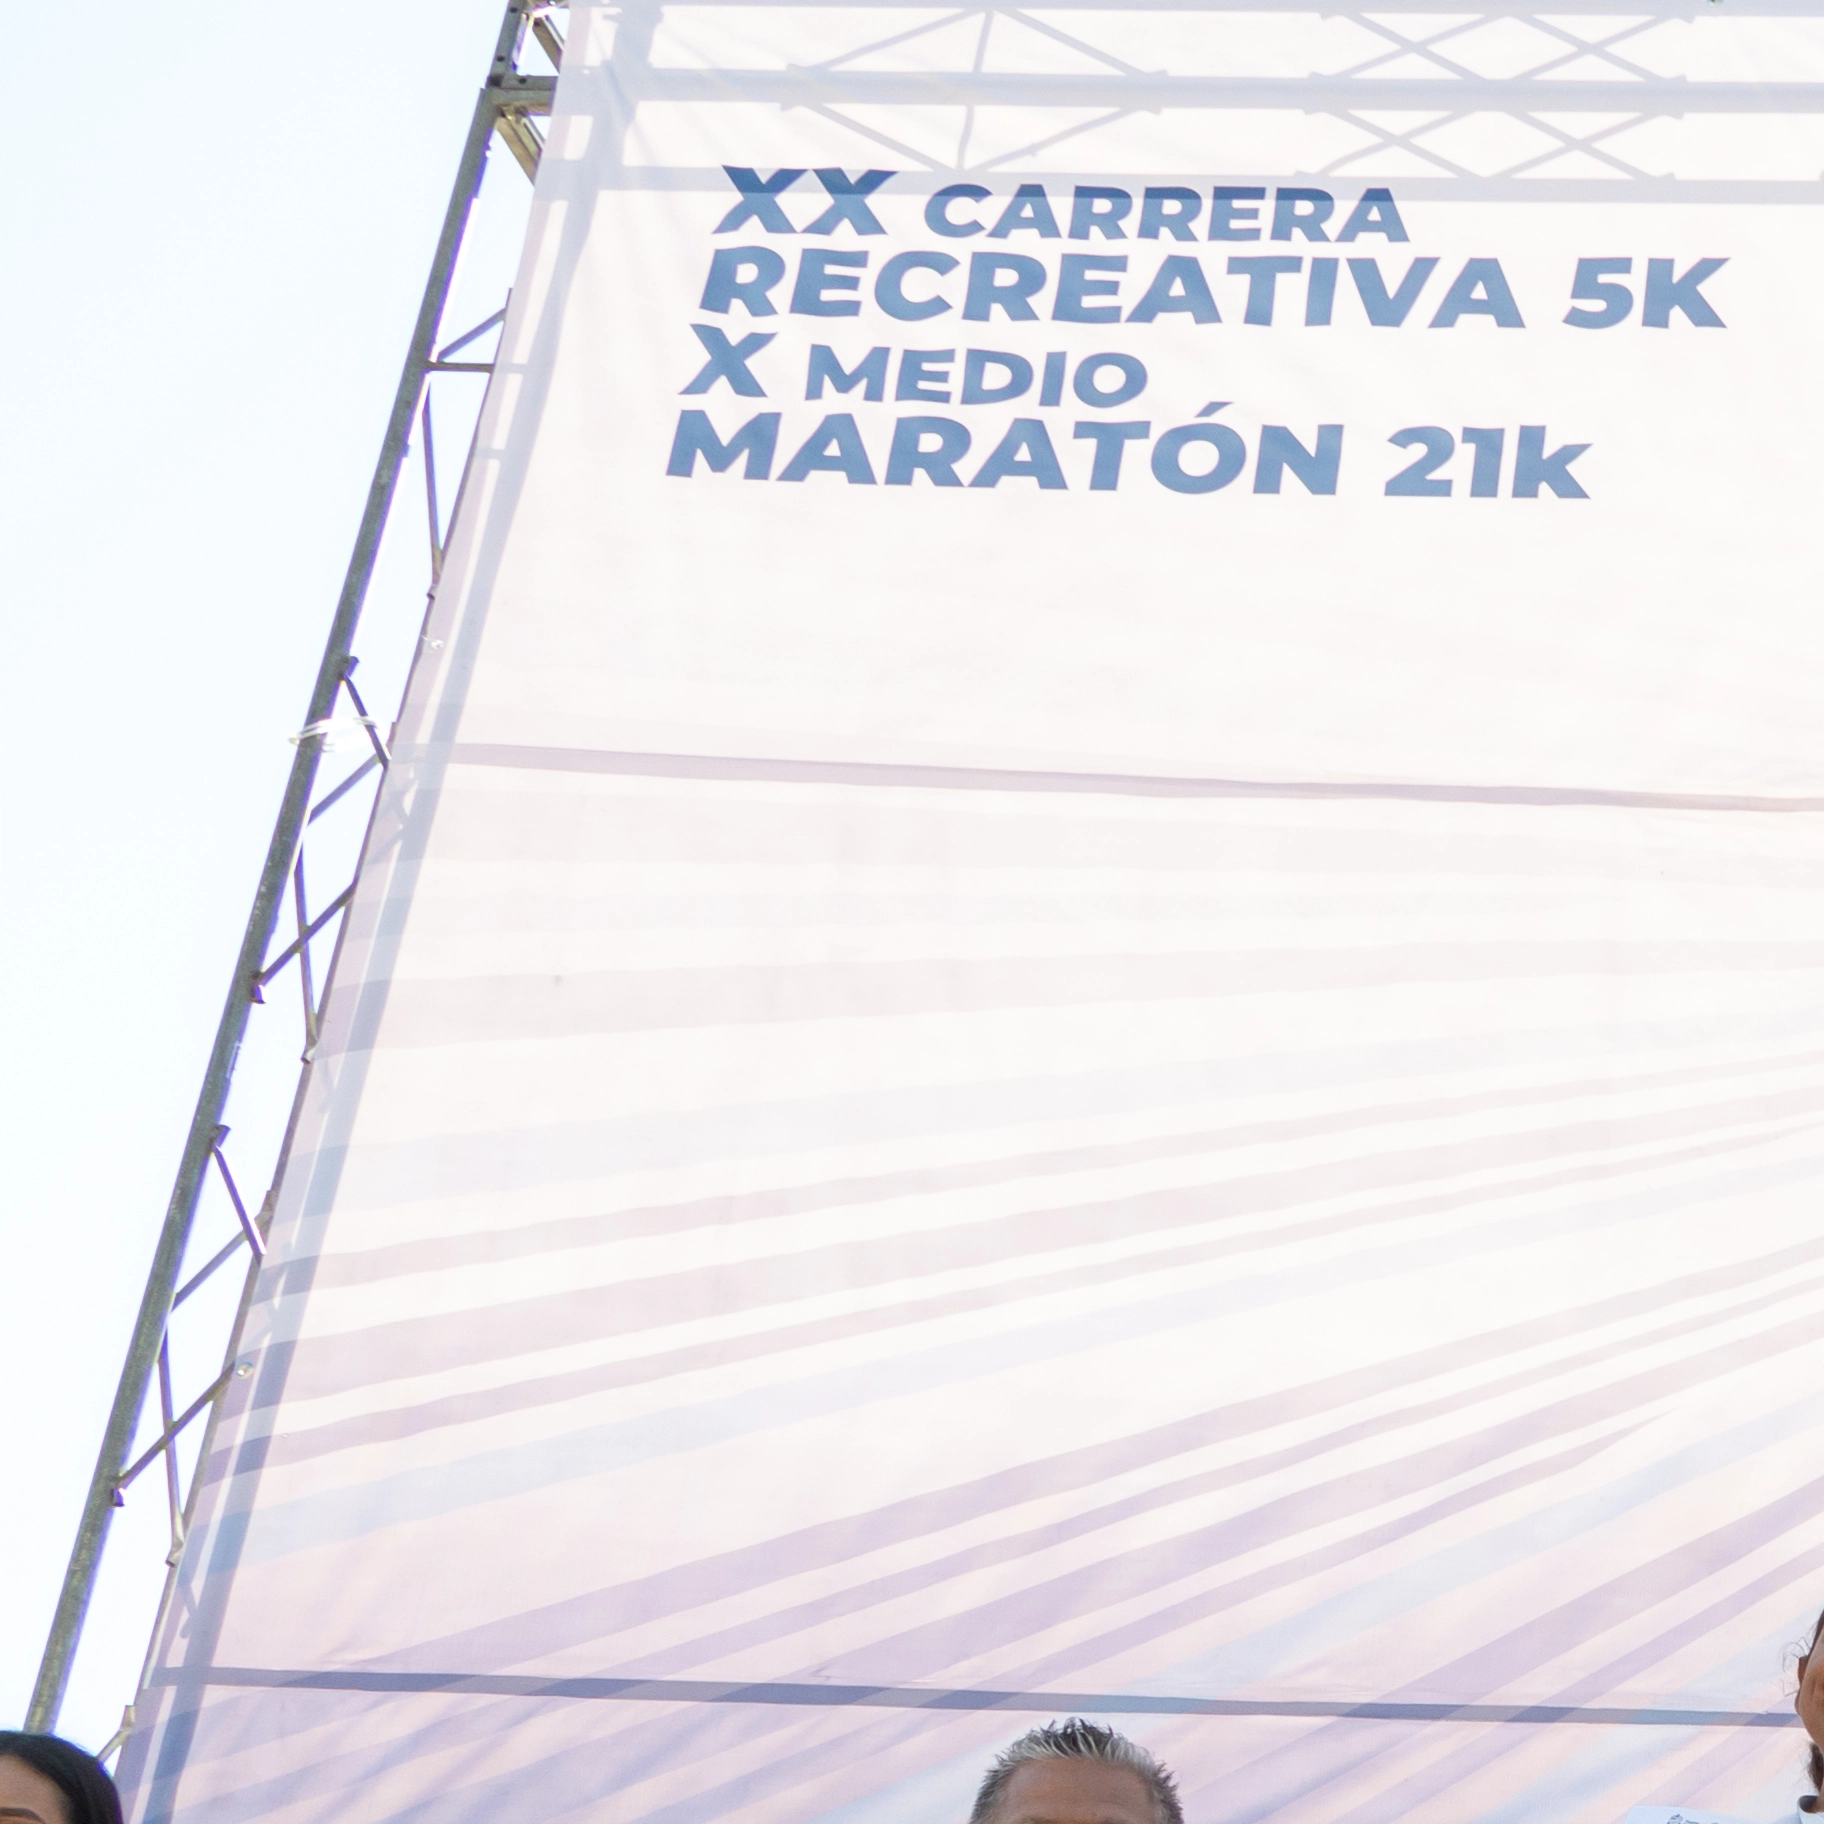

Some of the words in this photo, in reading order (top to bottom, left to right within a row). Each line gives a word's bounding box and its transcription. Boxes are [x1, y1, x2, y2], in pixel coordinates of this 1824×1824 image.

[711, 165, 897, 235] XX
[923, 184, 1411, 243] CARRERA
[698, 248, 1526, 328] RECREATIVA
[1562, 255, 1730, 330] 5K
[679, 324, 778, 399] X
[804, 344, 1148, 408] MEDIO
[665, 402, 1344, 494] MARATÓN
[1383, 424, 1593, 500] 21k
